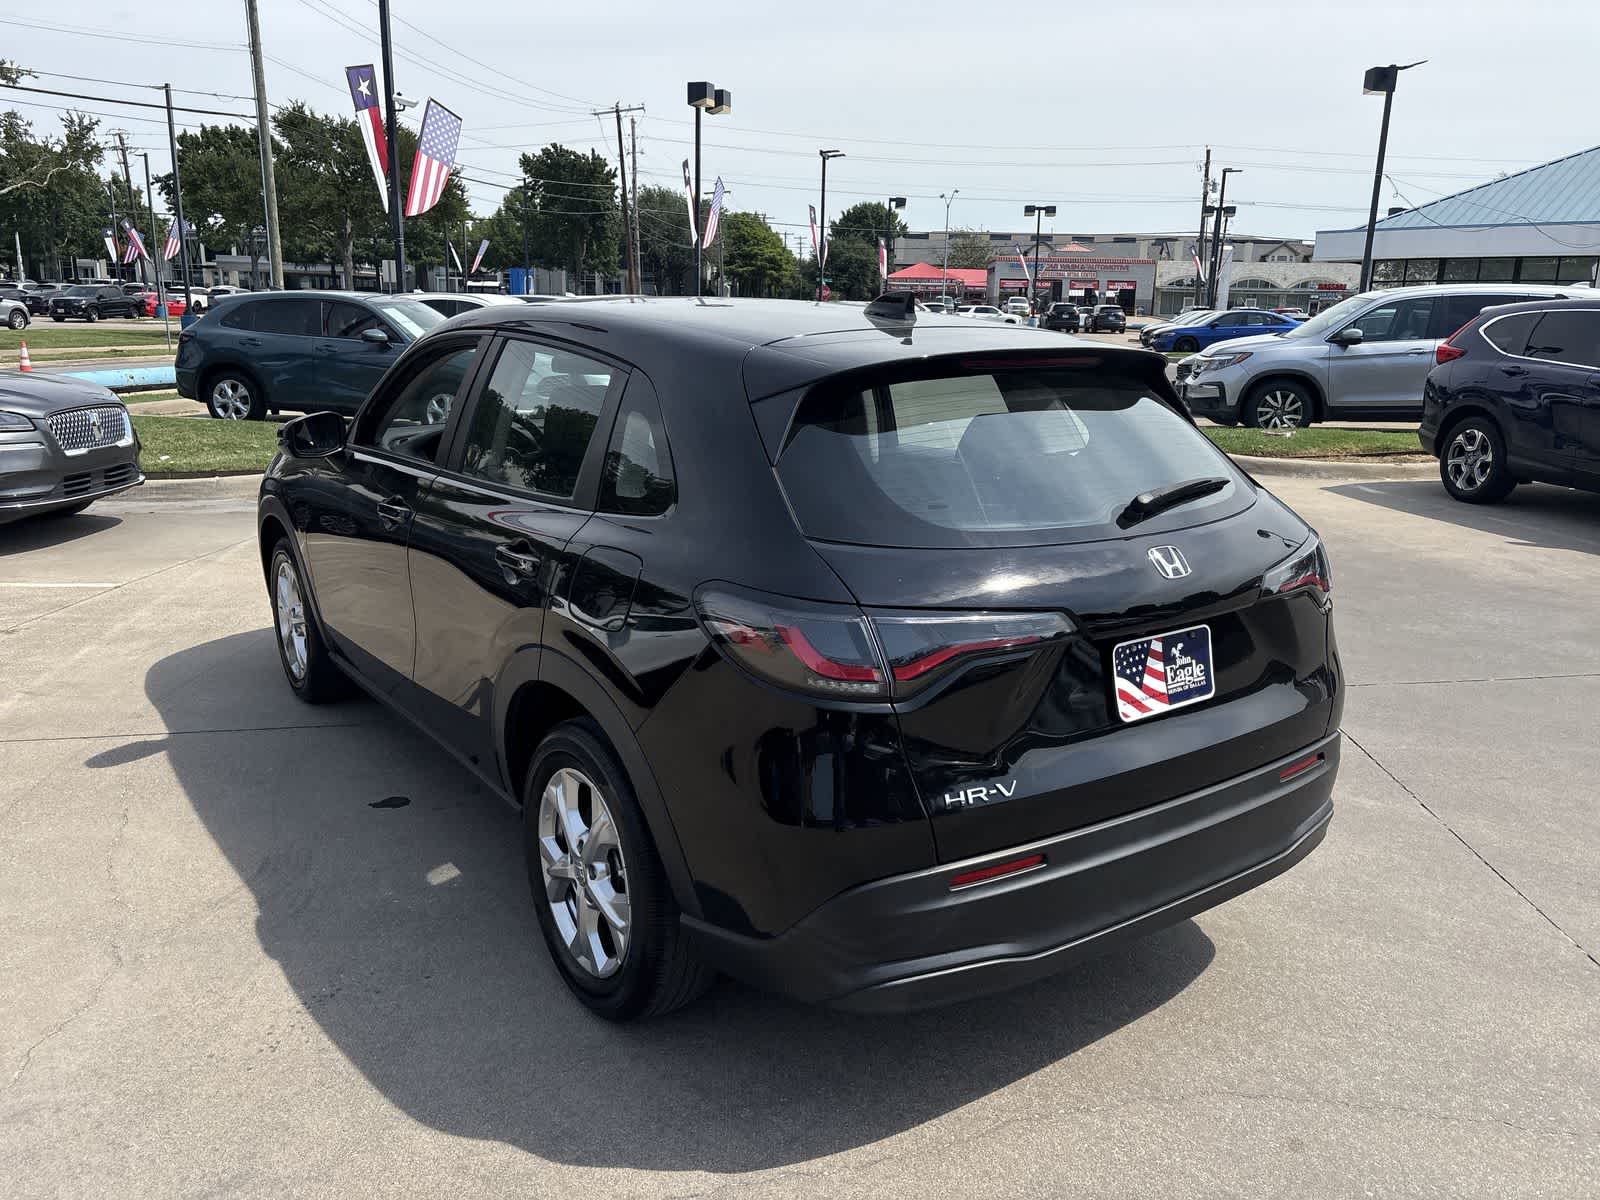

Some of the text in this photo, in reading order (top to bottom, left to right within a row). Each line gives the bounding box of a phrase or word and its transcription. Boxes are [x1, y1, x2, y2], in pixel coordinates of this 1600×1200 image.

[1165, 659, 1205, 685] Eagle
[1175, 655, 1191, 669] John
[944, 779, 1017, 807] HR-V
